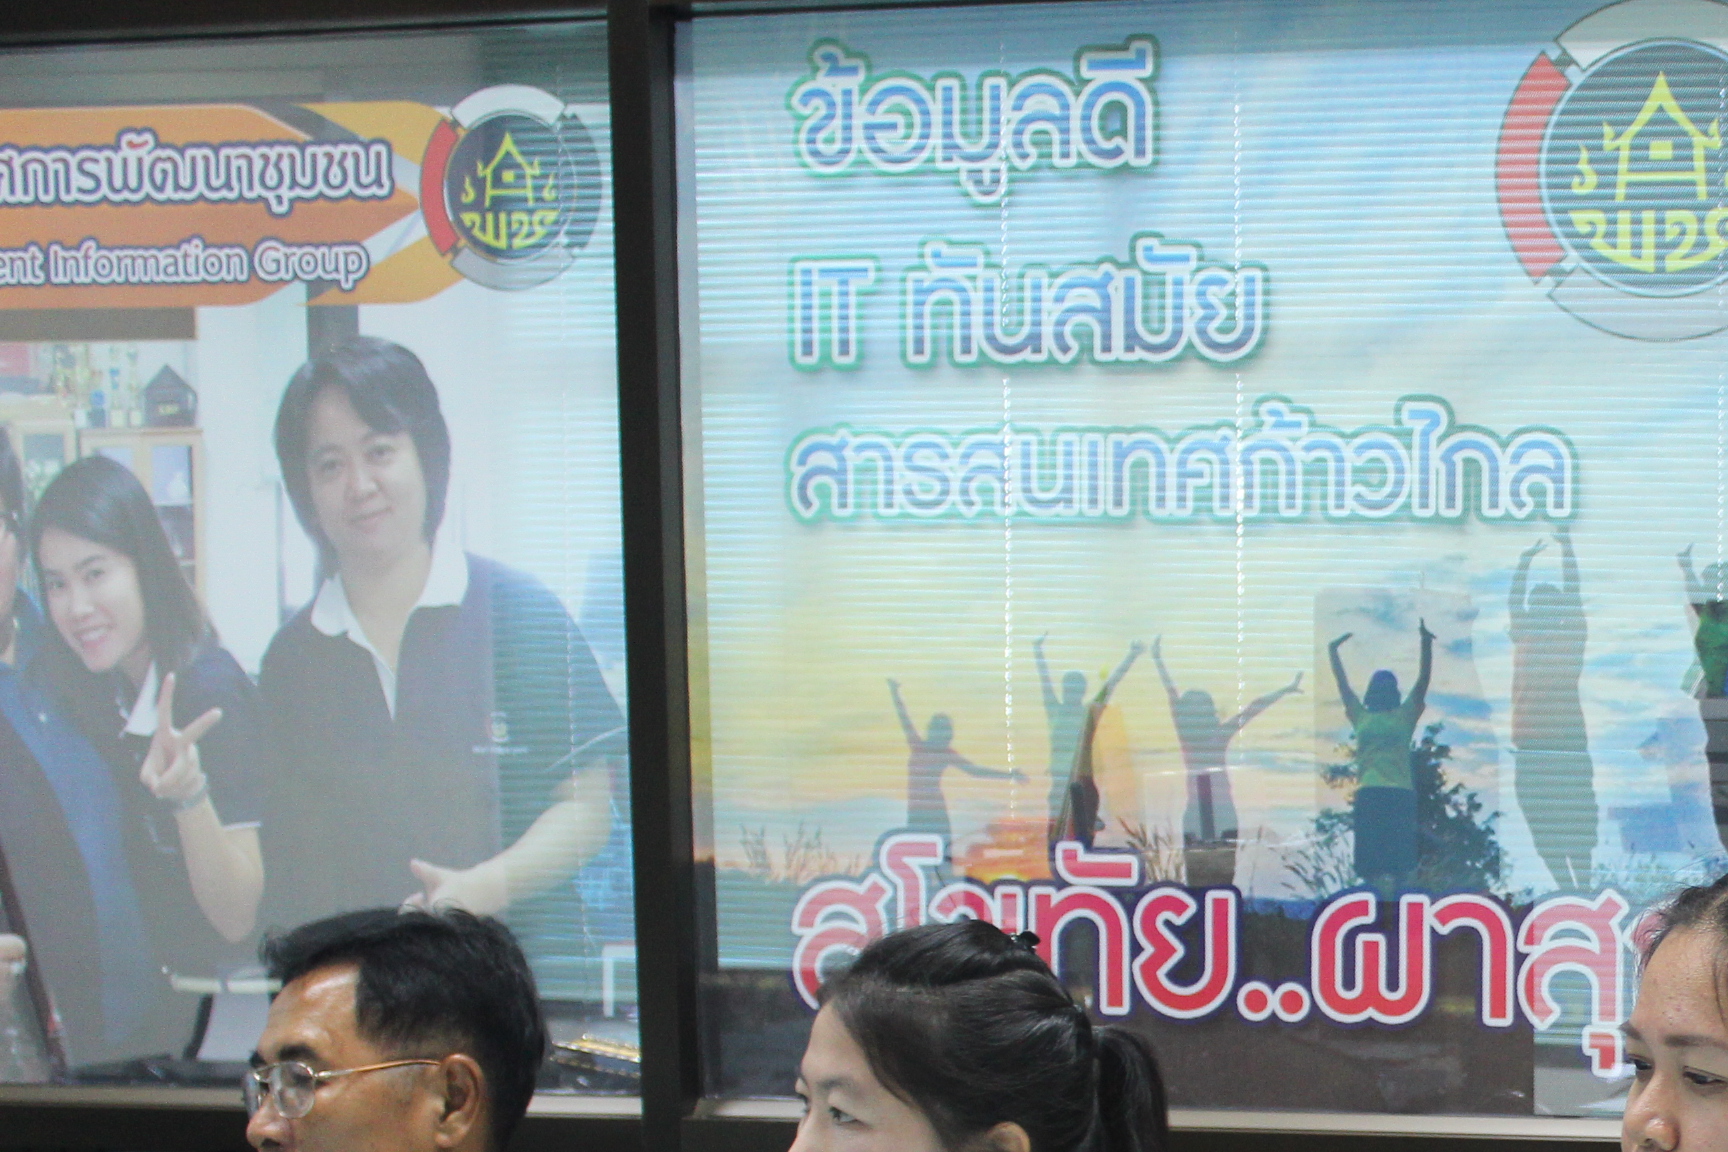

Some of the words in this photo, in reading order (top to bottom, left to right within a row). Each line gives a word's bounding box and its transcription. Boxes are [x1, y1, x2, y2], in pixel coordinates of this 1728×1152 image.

[792, 40, 1156, 203] ข้อมูลดี
[49, 239, 249, 284] Information
[254, 239, 369, 291] Group
[795, 260, 875, 365] IT
[904, 238, 1265, 365] ทันสมัย
[792, 400, 1573, 518] สารสนเทศก้าวไกล
